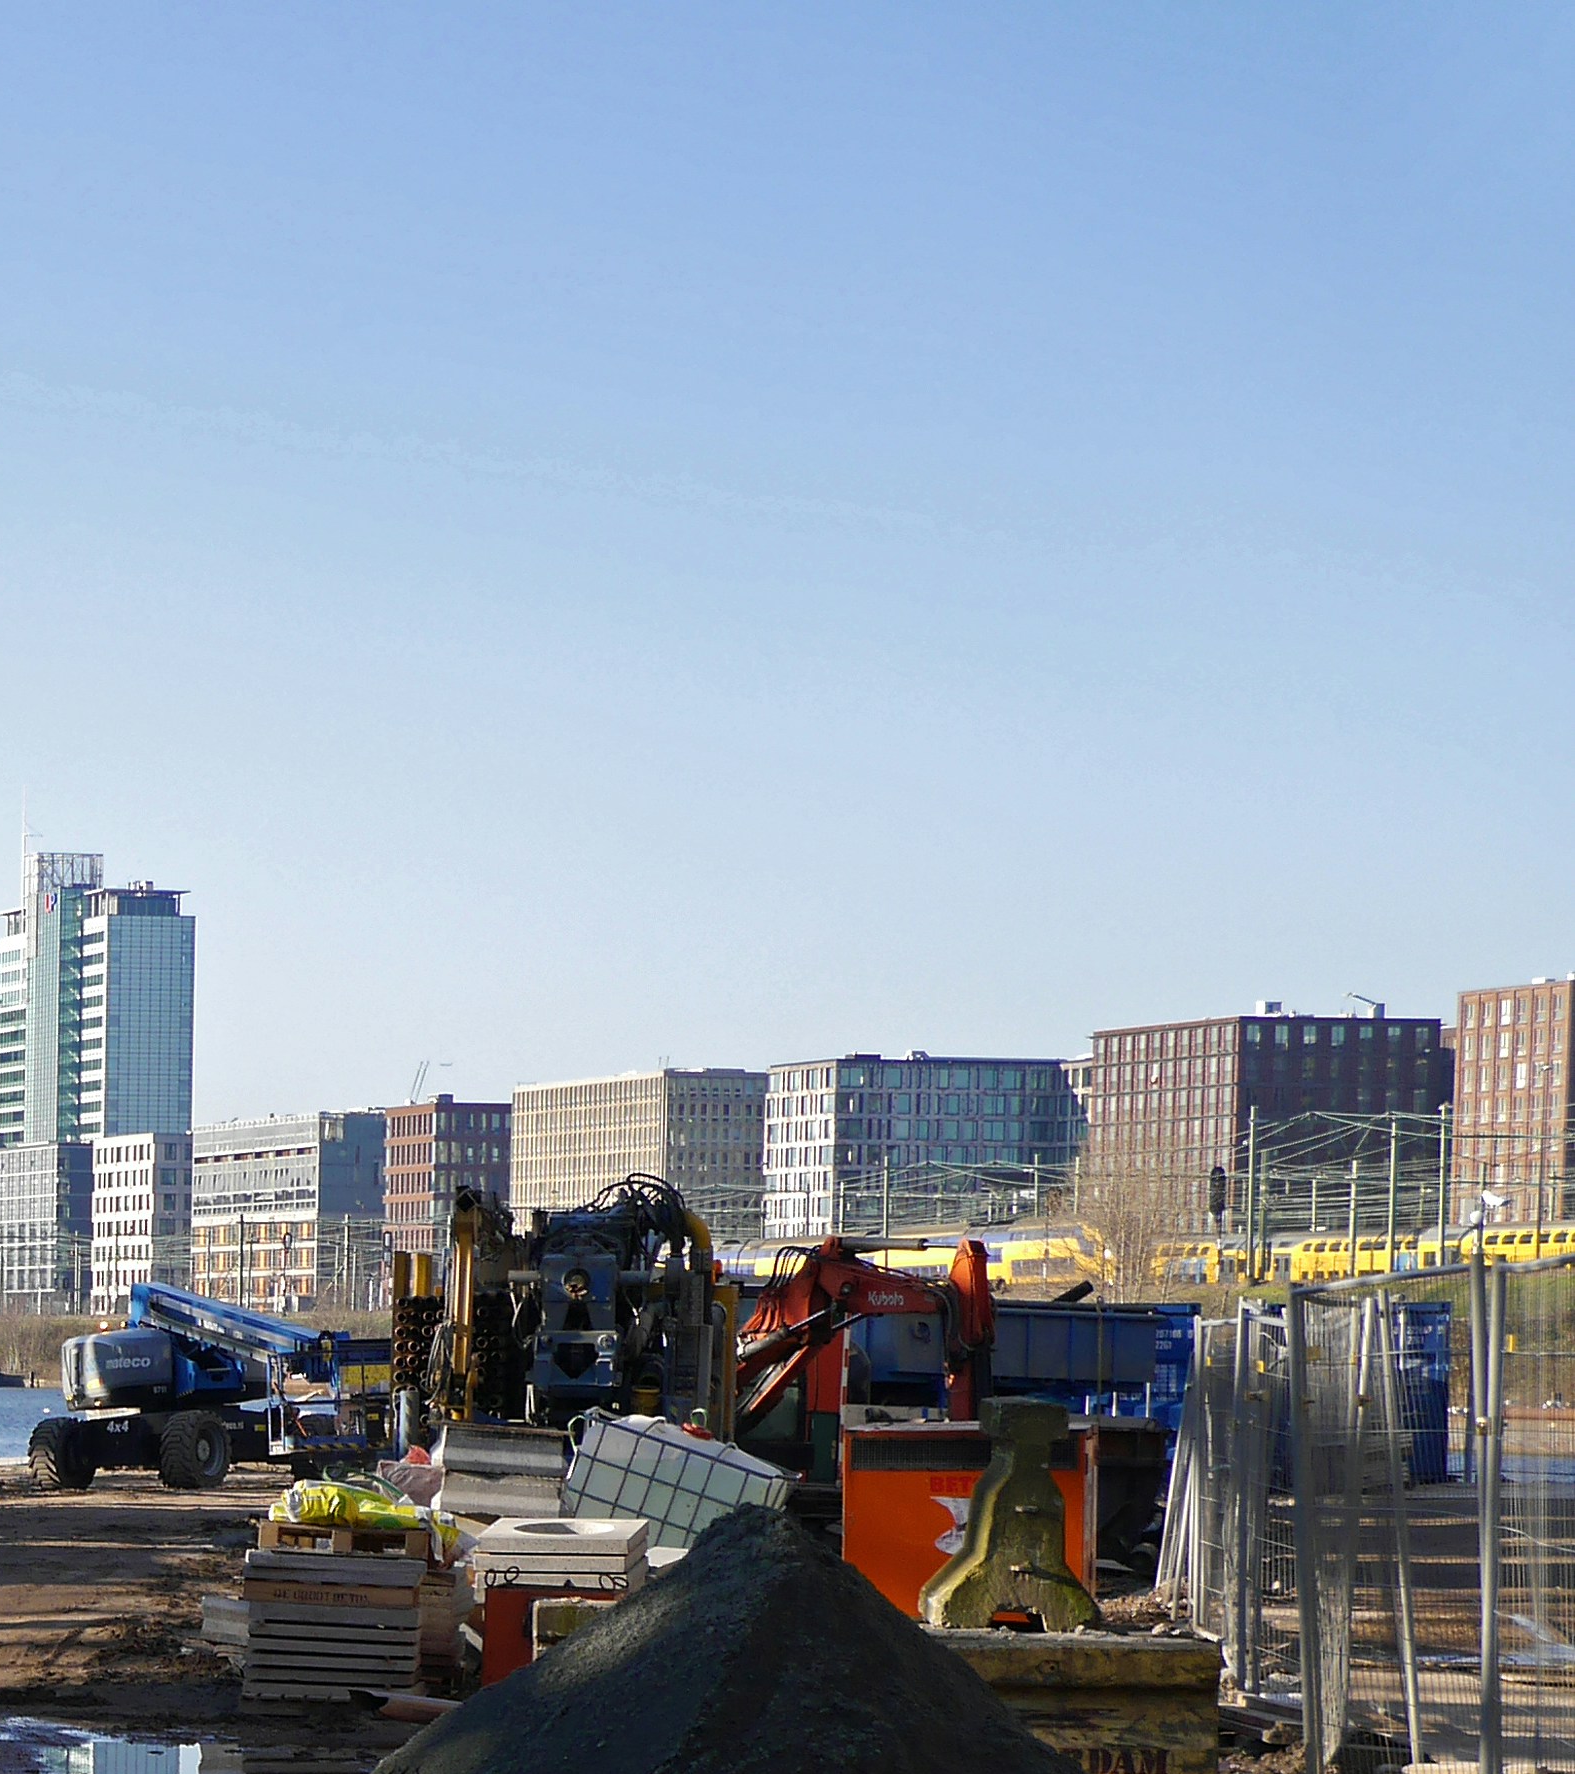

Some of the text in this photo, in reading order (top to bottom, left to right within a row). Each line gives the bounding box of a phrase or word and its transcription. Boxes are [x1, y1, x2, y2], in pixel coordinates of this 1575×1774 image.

[868, 1291, 905, 1306] Kubota
[107, 1420, 129, 1433] 4x4
[931, 1476, 972, 1493] BET
